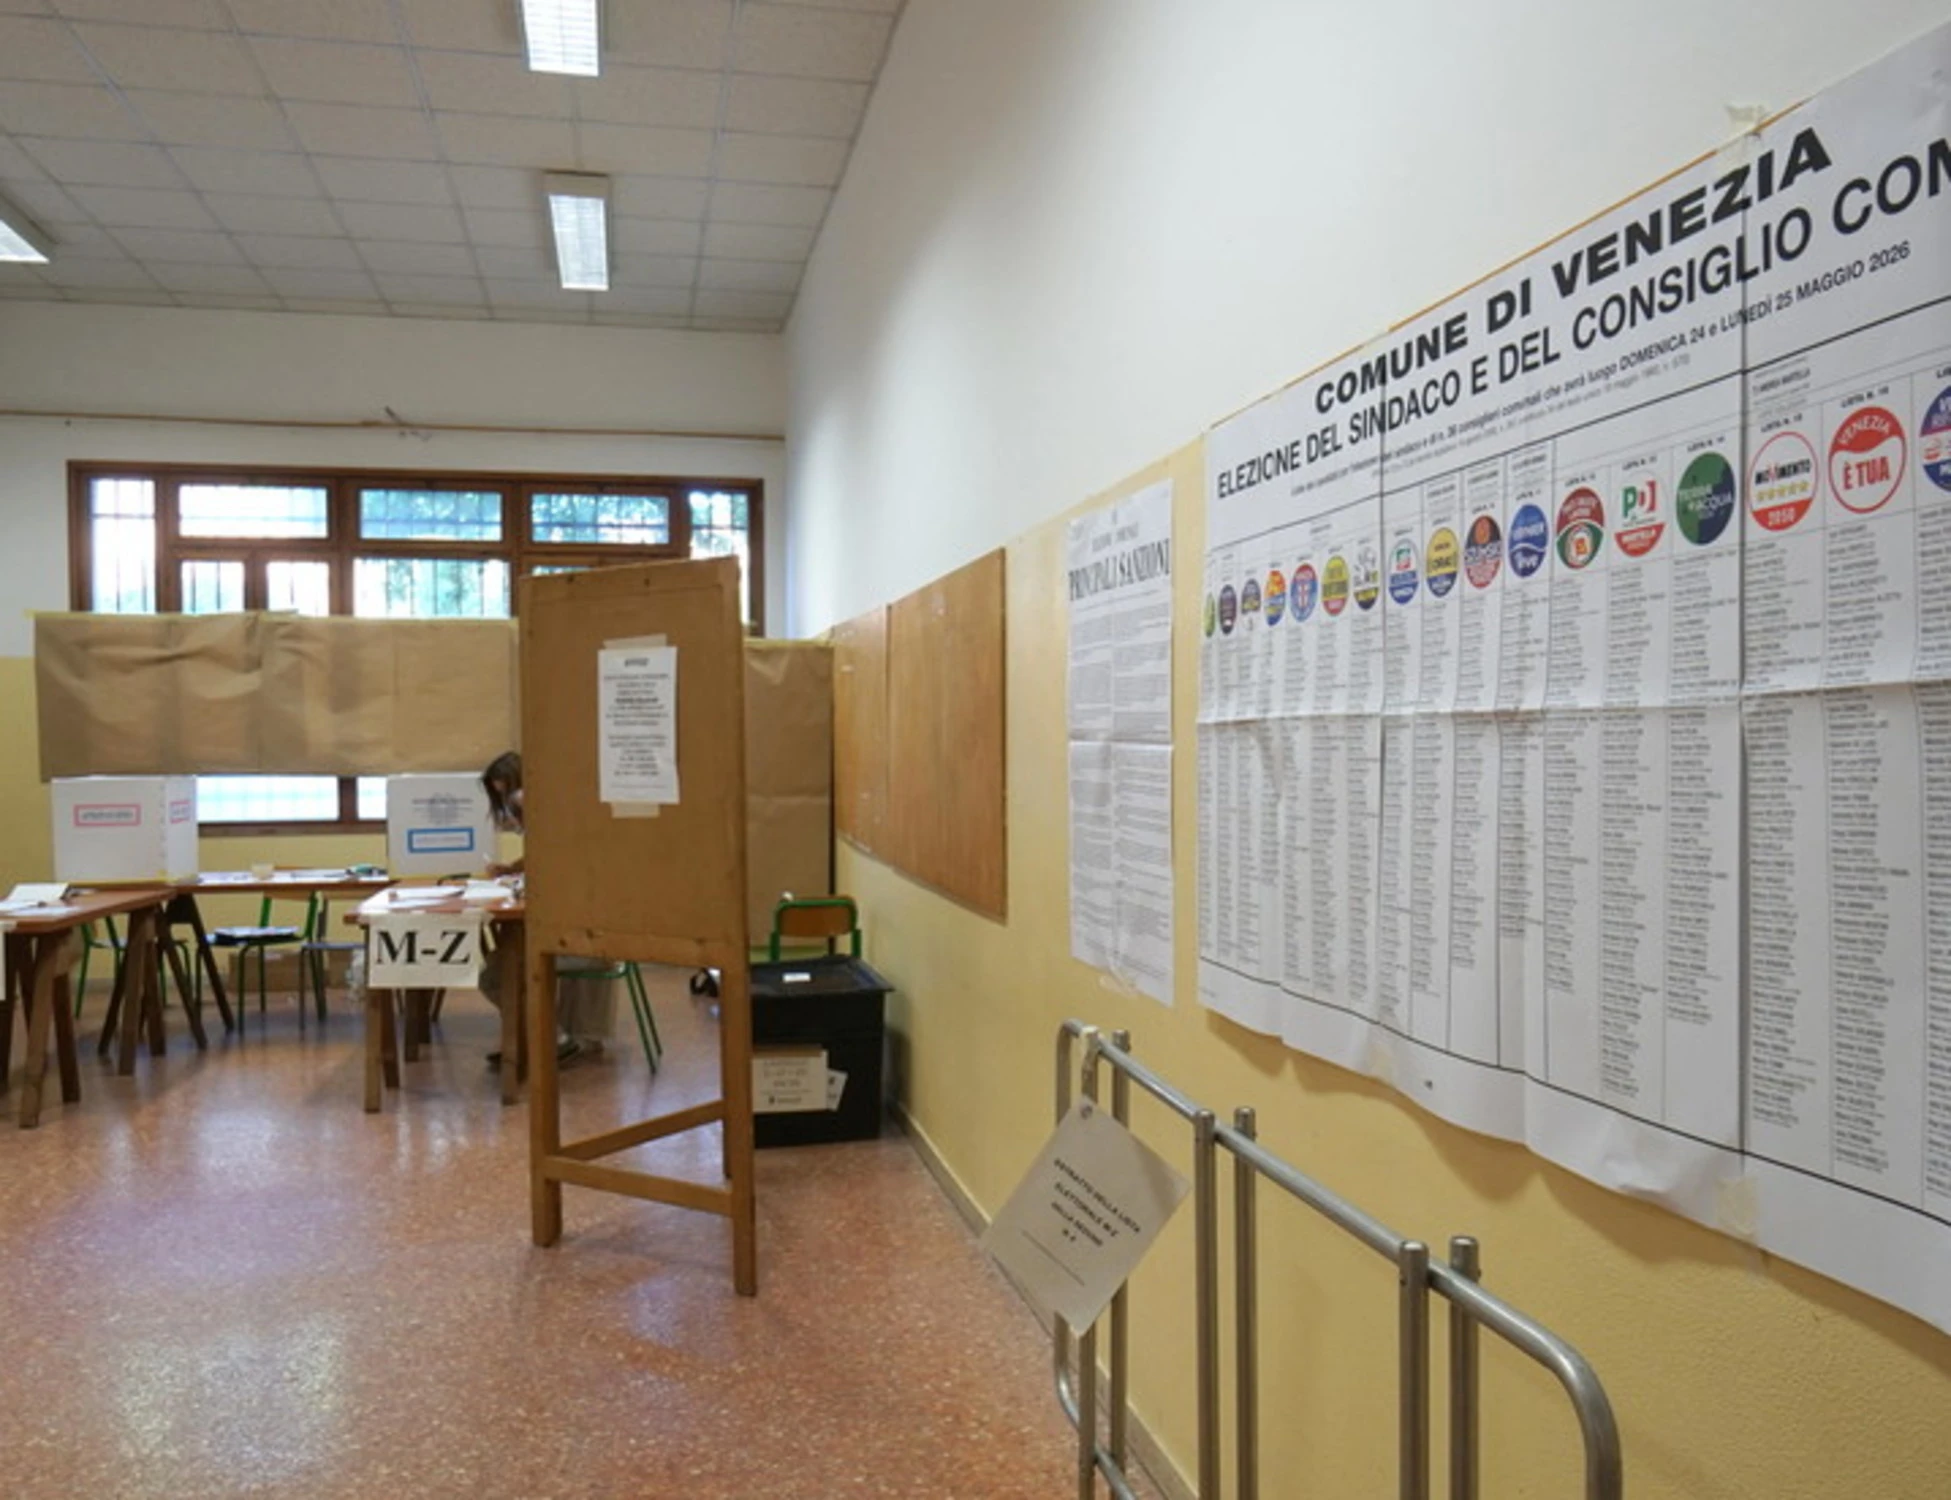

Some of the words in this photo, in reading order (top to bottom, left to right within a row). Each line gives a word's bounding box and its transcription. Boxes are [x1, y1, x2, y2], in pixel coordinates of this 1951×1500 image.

[1315, 313, 1468, 414] COMUNE
[1487, 280, 1531, 335] DI
[1551, 127, 1832, 298] VENEZIA
[1588, 362, 1617, 388] luogo
[1619, 334, 1688, 371] DOMENICA
[1690, 324, 1706, 345] 24
[1709, 323, 1718, 337] e
[1720, 294, 1773, 332] LUNEDÌ
[1776, 290, 1793, 311] 25
[1796, 259, 1865, 302] MAGGIO
[1869, 239, 1912, 273] 2026
[1218, 440, 1300, 498] ELEZIONE
[1307, 423, 1342, 465] DEL
[1349, 369, 1461, 445] SINDACO
[1472, 356, 1489, 395] E
[1499, 327, 1561, 384] DEL
[1572, 207, 1813, 349] CONSIGLIO
[1838, 415, 1891, 446] VENEZIA
[1855, 456, 1891, 488] TUA
[376, 930, 471, 965] M-Z
[1118, 1211, 1142, 1233] LISTA
